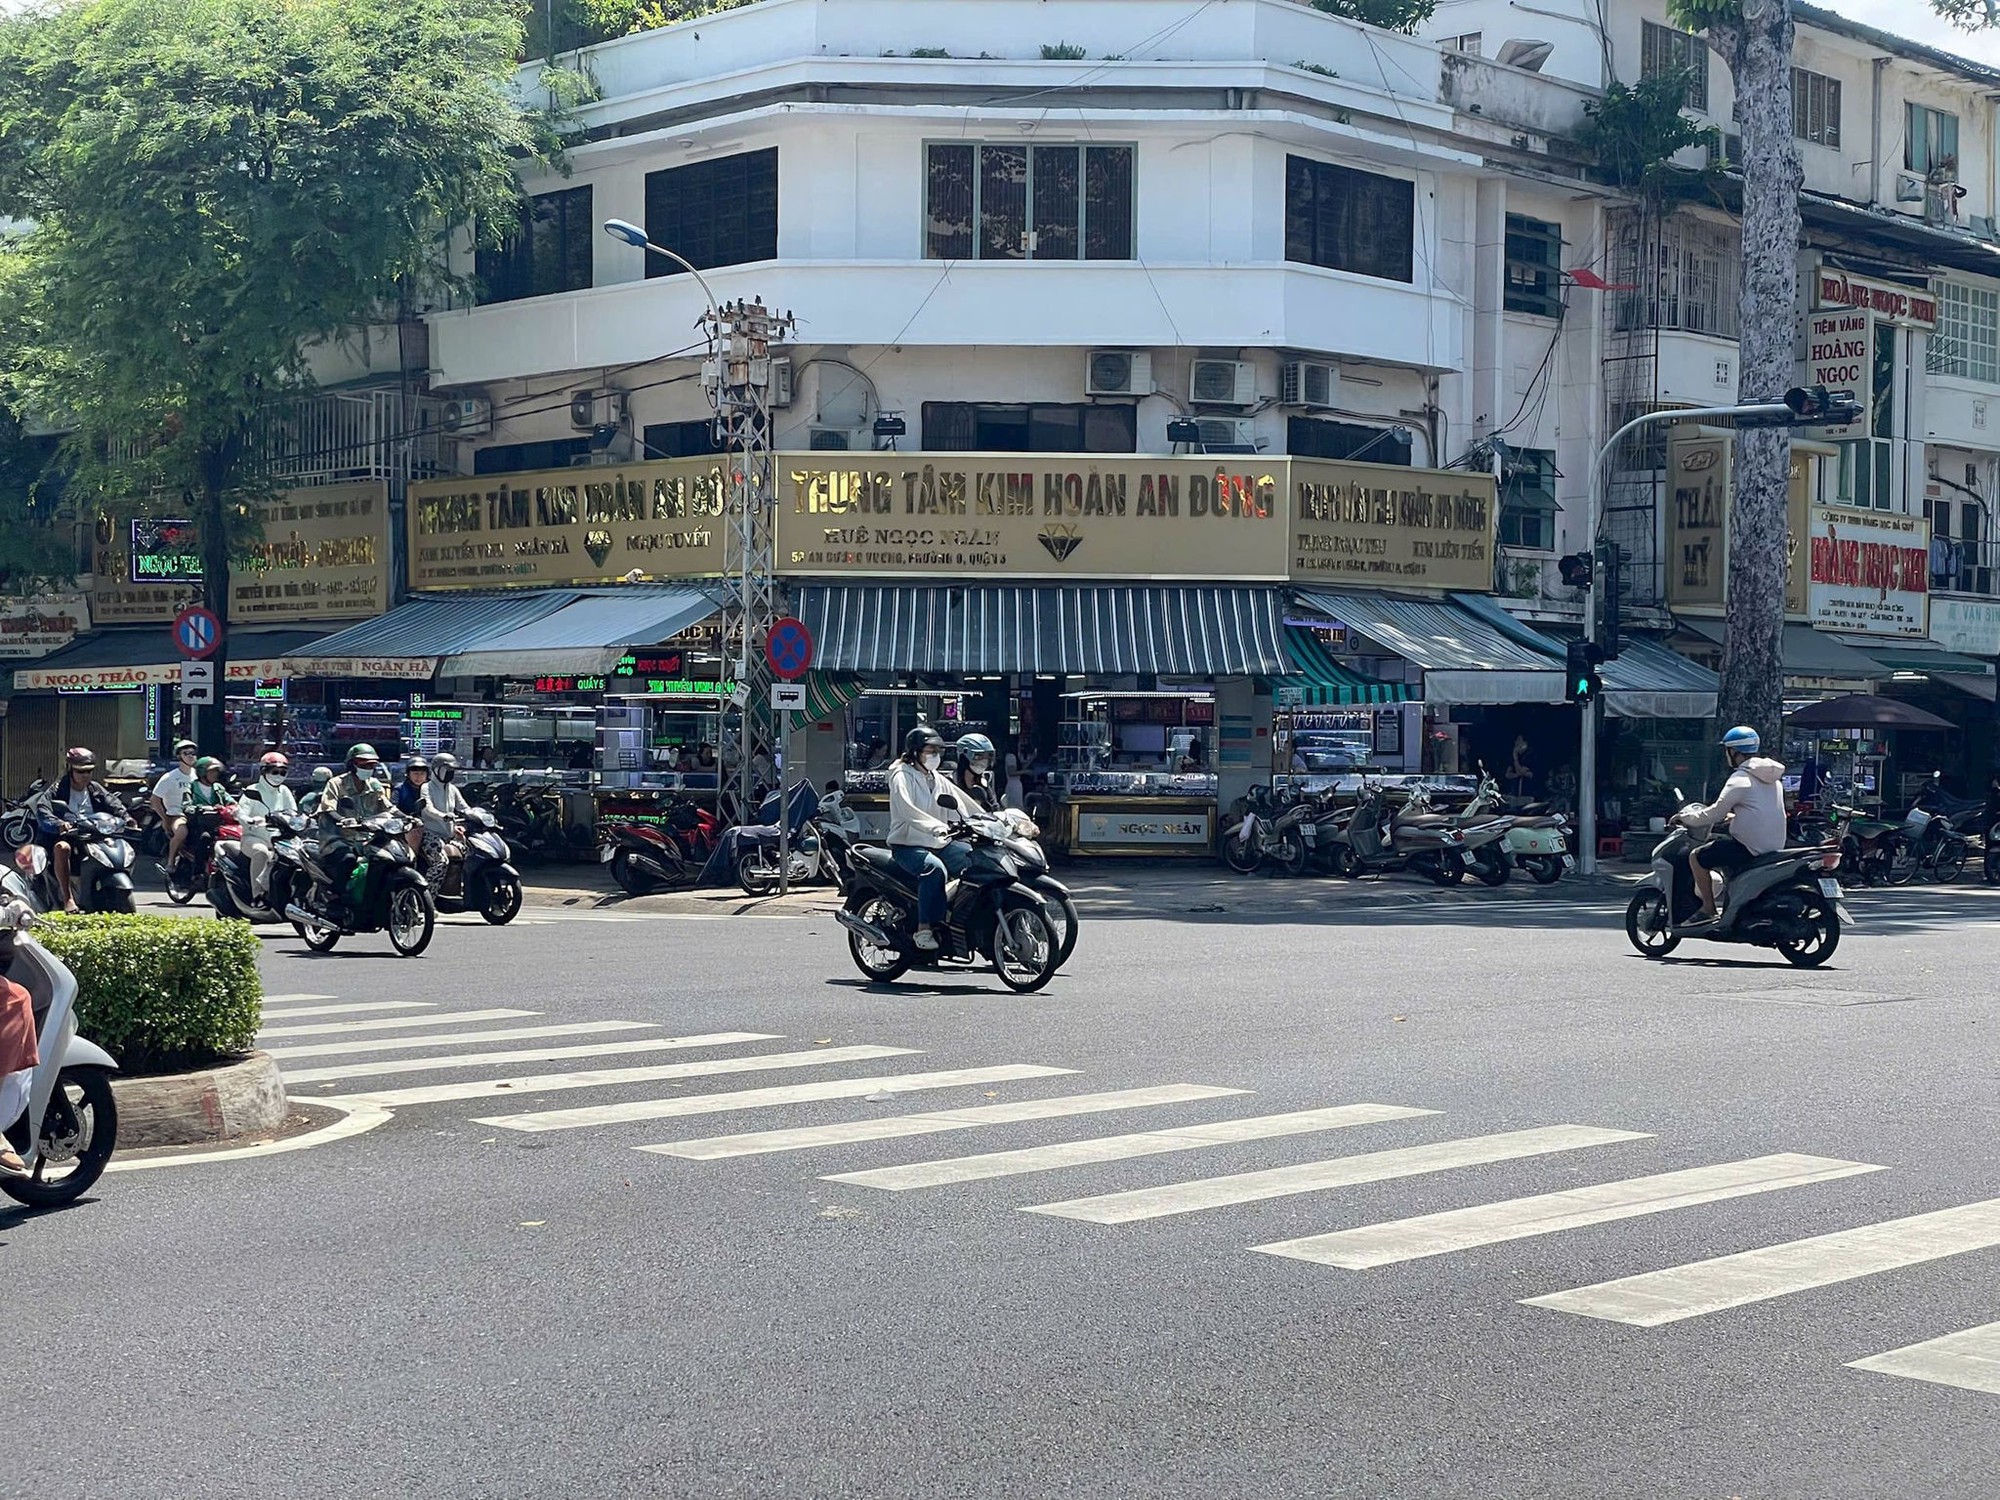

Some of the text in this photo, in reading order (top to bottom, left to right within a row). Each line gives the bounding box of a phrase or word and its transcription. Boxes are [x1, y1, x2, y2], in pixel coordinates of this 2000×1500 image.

[1813, 316, 1865, 335] TIỆM VÀNG
[1811, 338, 1866, 361] HOÀNG
[1815, 365, 1860, 386] NGỌC
[791, 463, 1276, 519] TRUNG TÂM KIM HOÀN AN ĐÔNG
[875, 529, 934, 548] NGỌC
[408, 659, 432, 672] HÀ
[98, 668, 147, 683] THẢO
[1118, 823, 1158, 836] NGỌC
